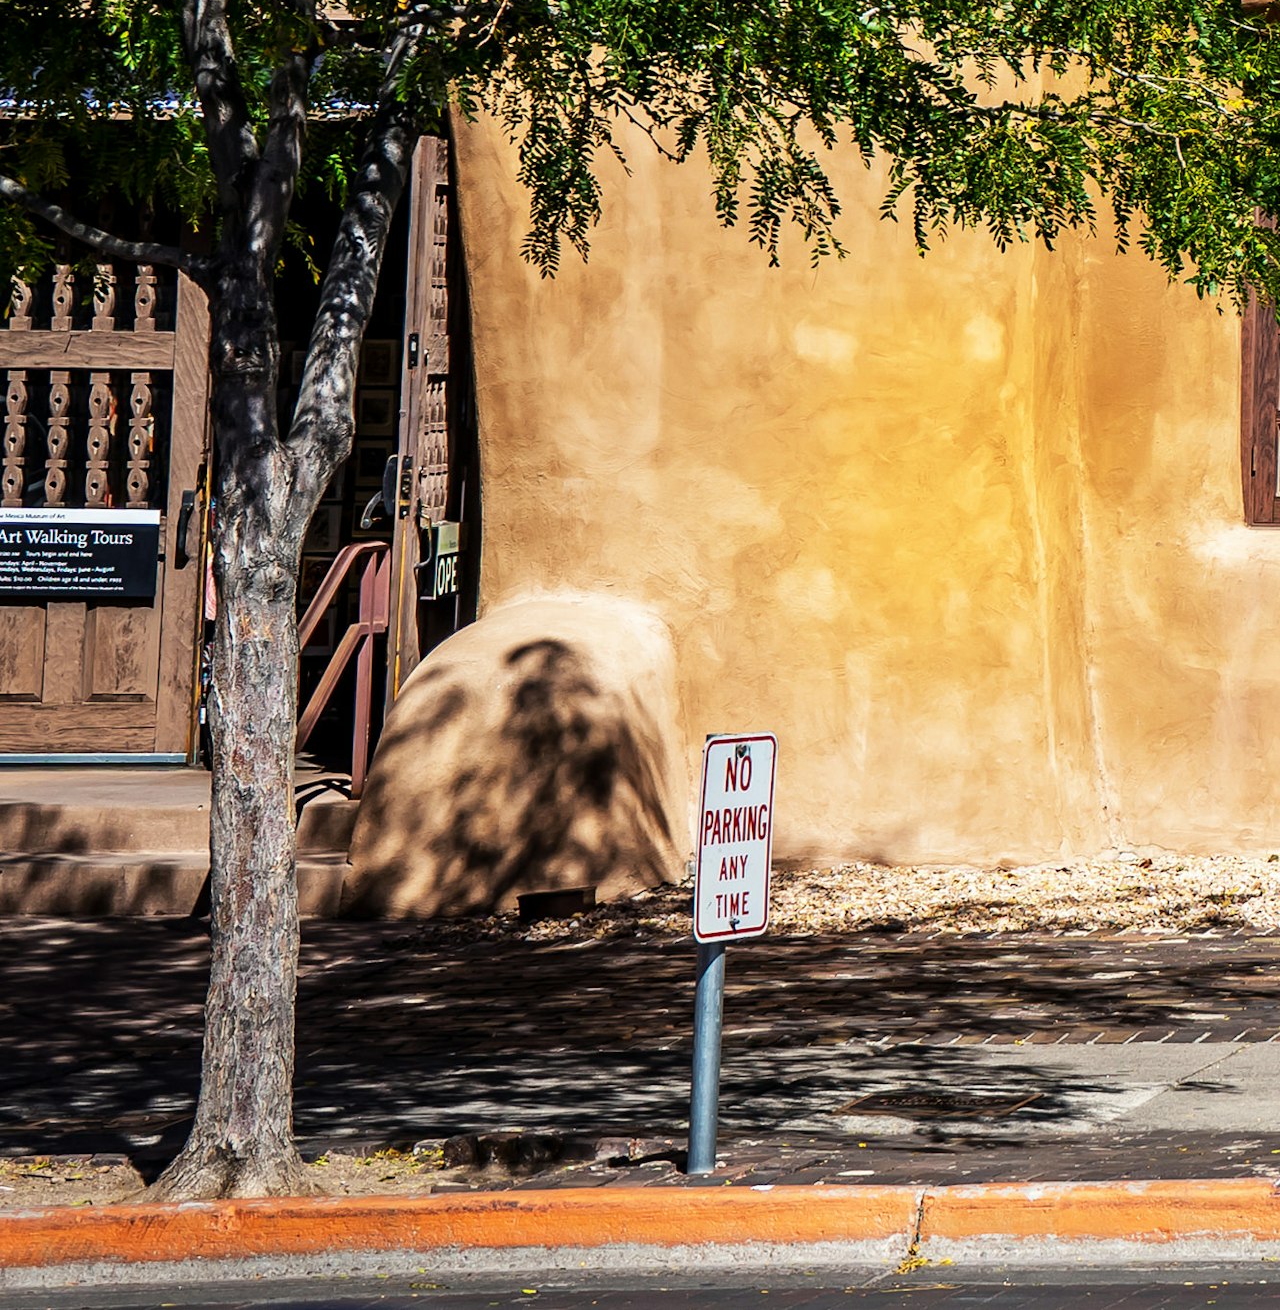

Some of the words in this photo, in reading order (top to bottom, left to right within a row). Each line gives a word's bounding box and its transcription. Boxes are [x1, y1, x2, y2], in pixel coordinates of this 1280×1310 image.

[0, 529, 22, 543] Art
[25, 529, 88, 549] Walking
[91, 530, 133, 544] Tours
[725, 756, 752, 792] NO
[704, 804, 768, 845] PARKING
[719, 854, 748, 881] ANY
[715, 891, 749, 919] TIME
